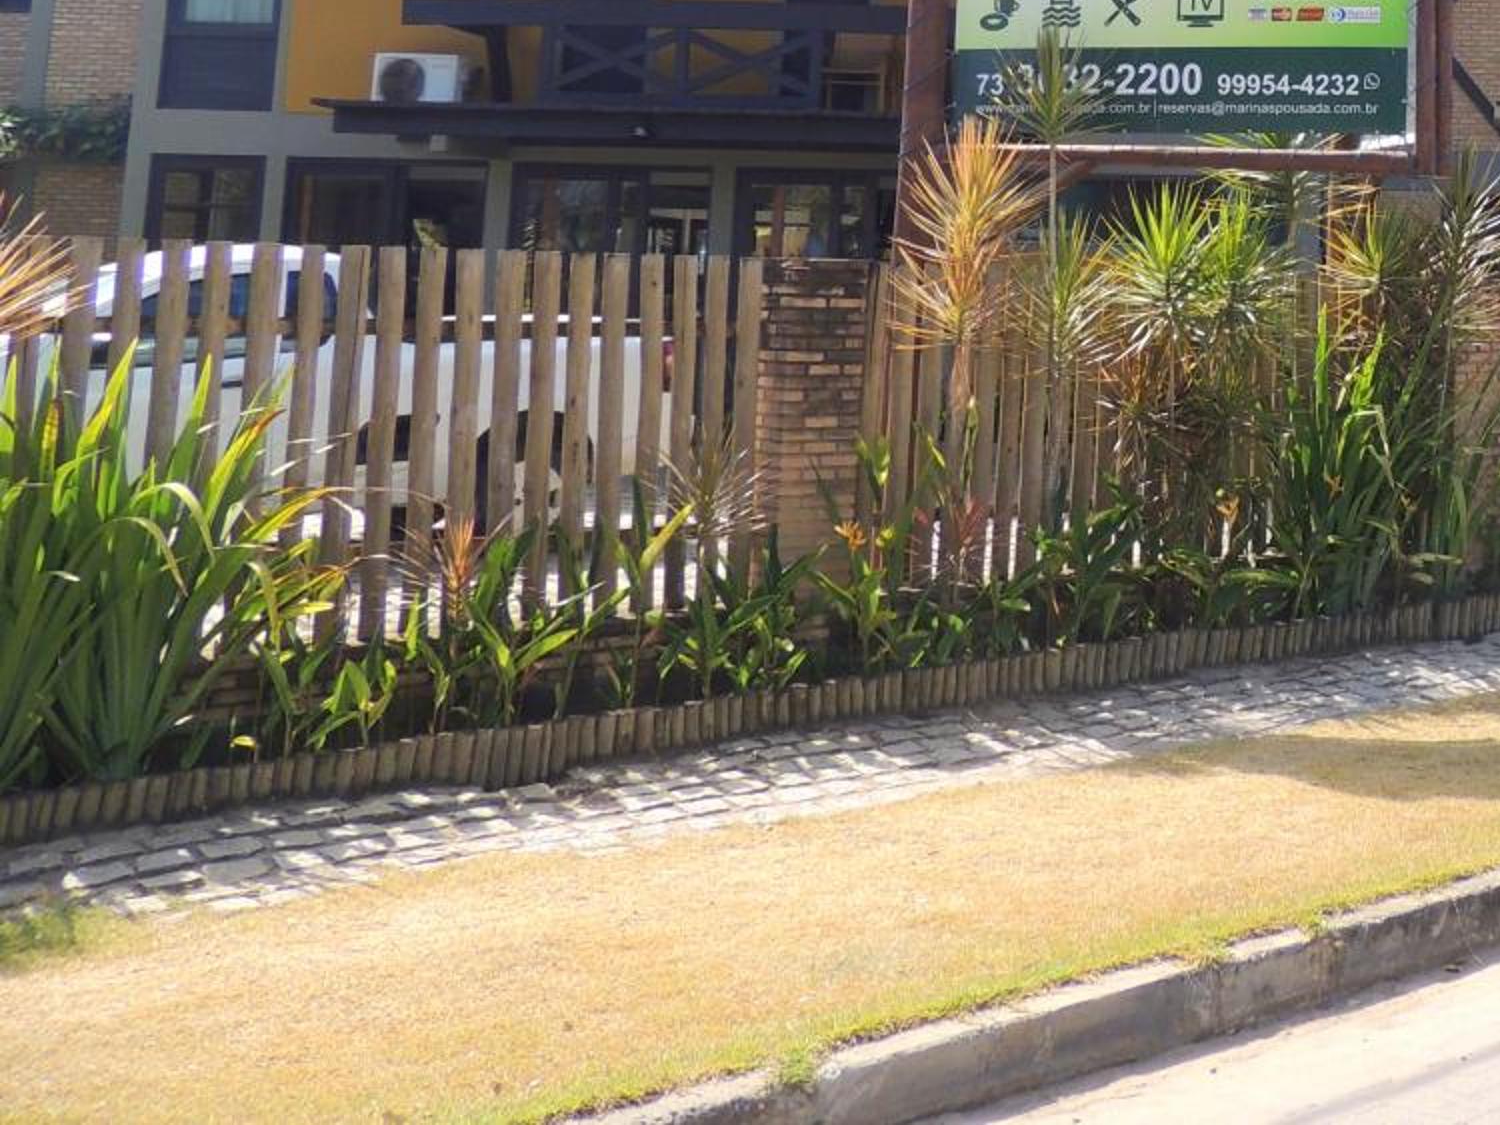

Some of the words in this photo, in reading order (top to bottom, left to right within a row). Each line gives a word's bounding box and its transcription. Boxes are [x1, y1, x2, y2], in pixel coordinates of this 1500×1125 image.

[976, 74, 1005, 95] 73
[1216, 74, 1360, 96] 99954-4232
[1158, 101, 1380, 116] reservas@marinaspousada.com.br
